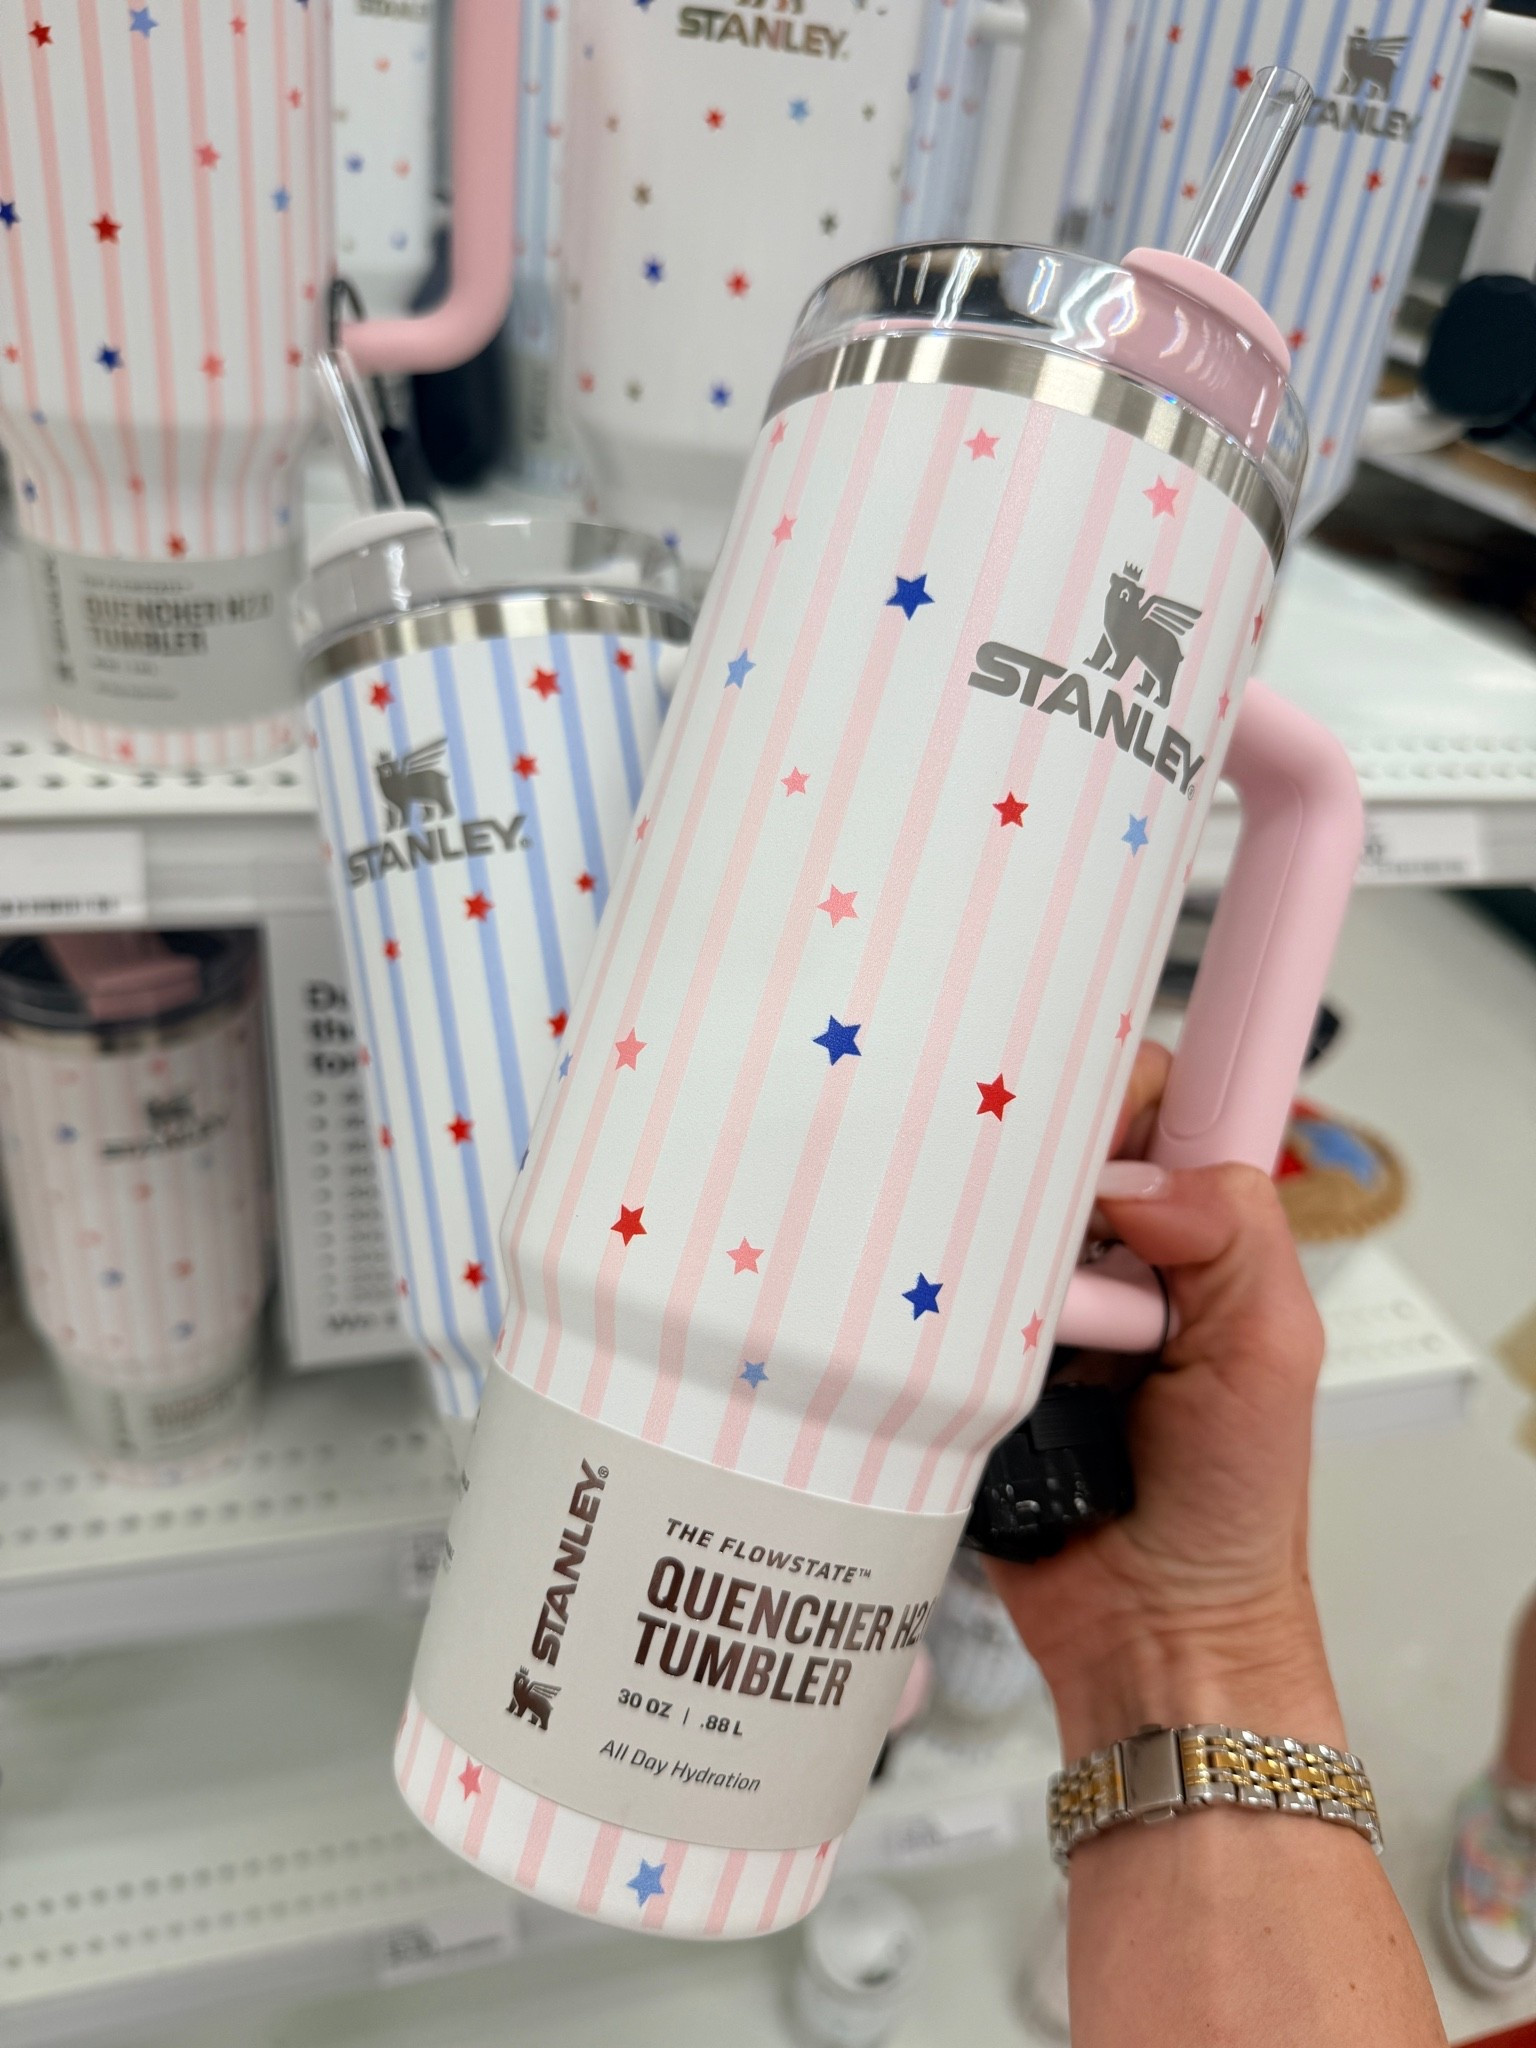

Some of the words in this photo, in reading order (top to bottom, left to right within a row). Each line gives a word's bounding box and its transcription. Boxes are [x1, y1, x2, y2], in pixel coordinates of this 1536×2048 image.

[666, 1517, 714, 1548] THE
[646, 1555, 894, 1652] QUENCHER
[633, 1611, 853, 1706] TUMBLER
[617, 1687, 643, 1709] 30
[645, 1697, 674, 1719] OZ
[699, 1714, 731, 1733] .88
[732, 1719, 743, 1737] L
[599, 1738, 629, 1762] All
[630, 1748, 669, 1777] Day
[670, 1760, 762, 1793] Hydration
